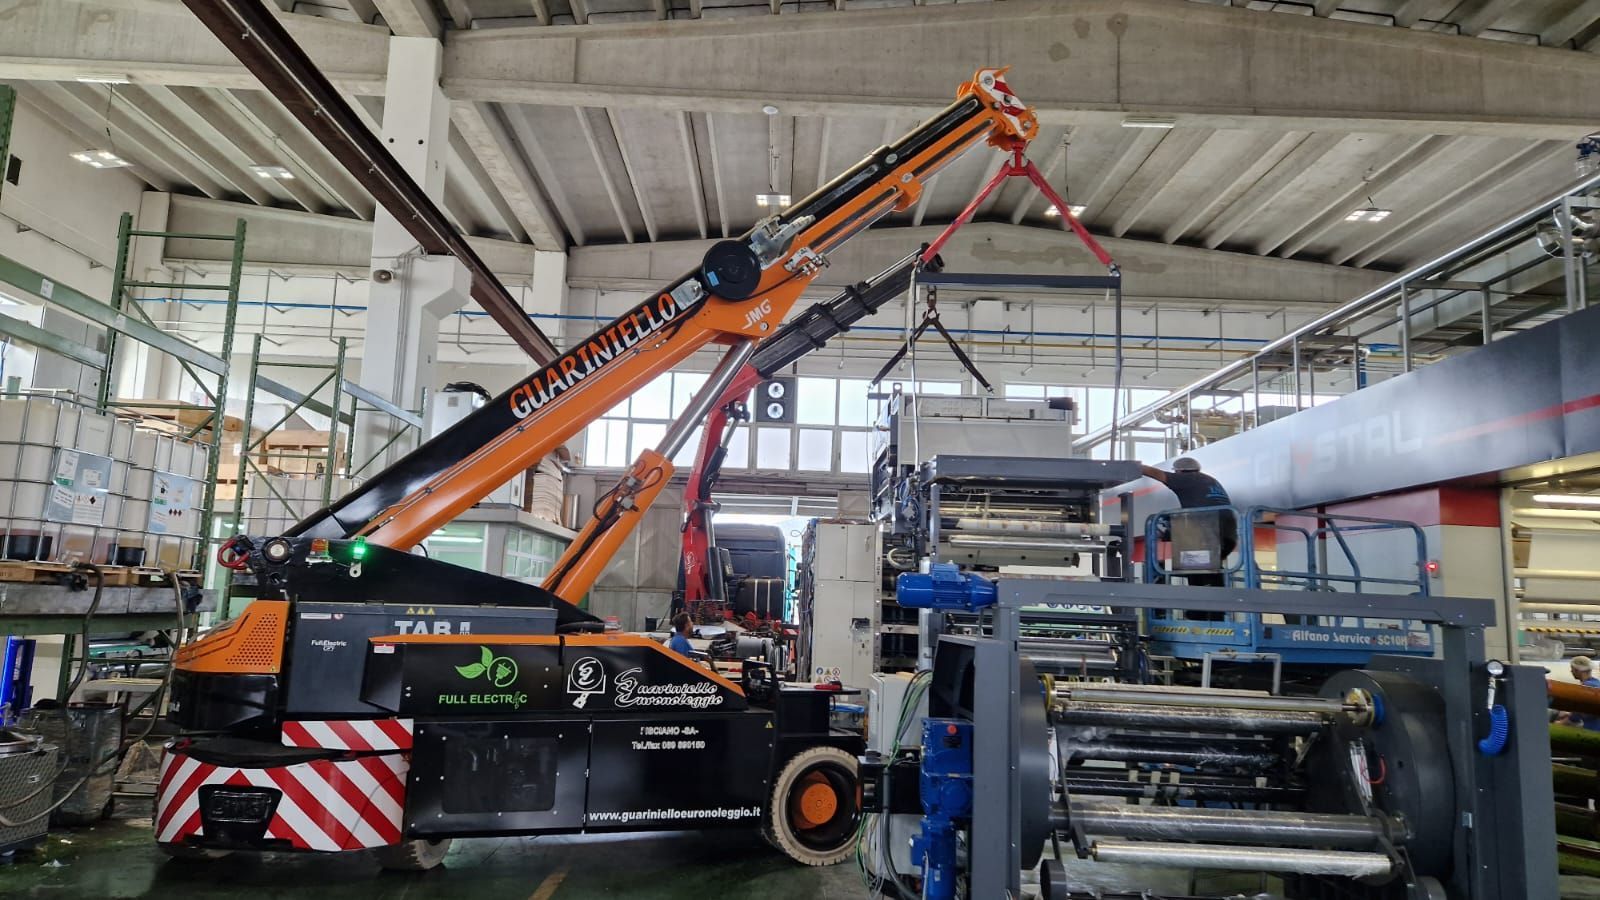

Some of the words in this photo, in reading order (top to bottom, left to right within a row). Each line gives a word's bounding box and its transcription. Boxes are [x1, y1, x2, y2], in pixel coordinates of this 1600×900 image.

[741, 299, 772, 329] JMG
[509, 293, 676, 419] GUARINIELLO
[1292, 630, 1330, 642] Alfano
[1332, 632, 1371, 645] Service
[439, 694, 467, 704] FULL
[589, 806, 761, 822] www.guarinielloeuronoleggio.it
